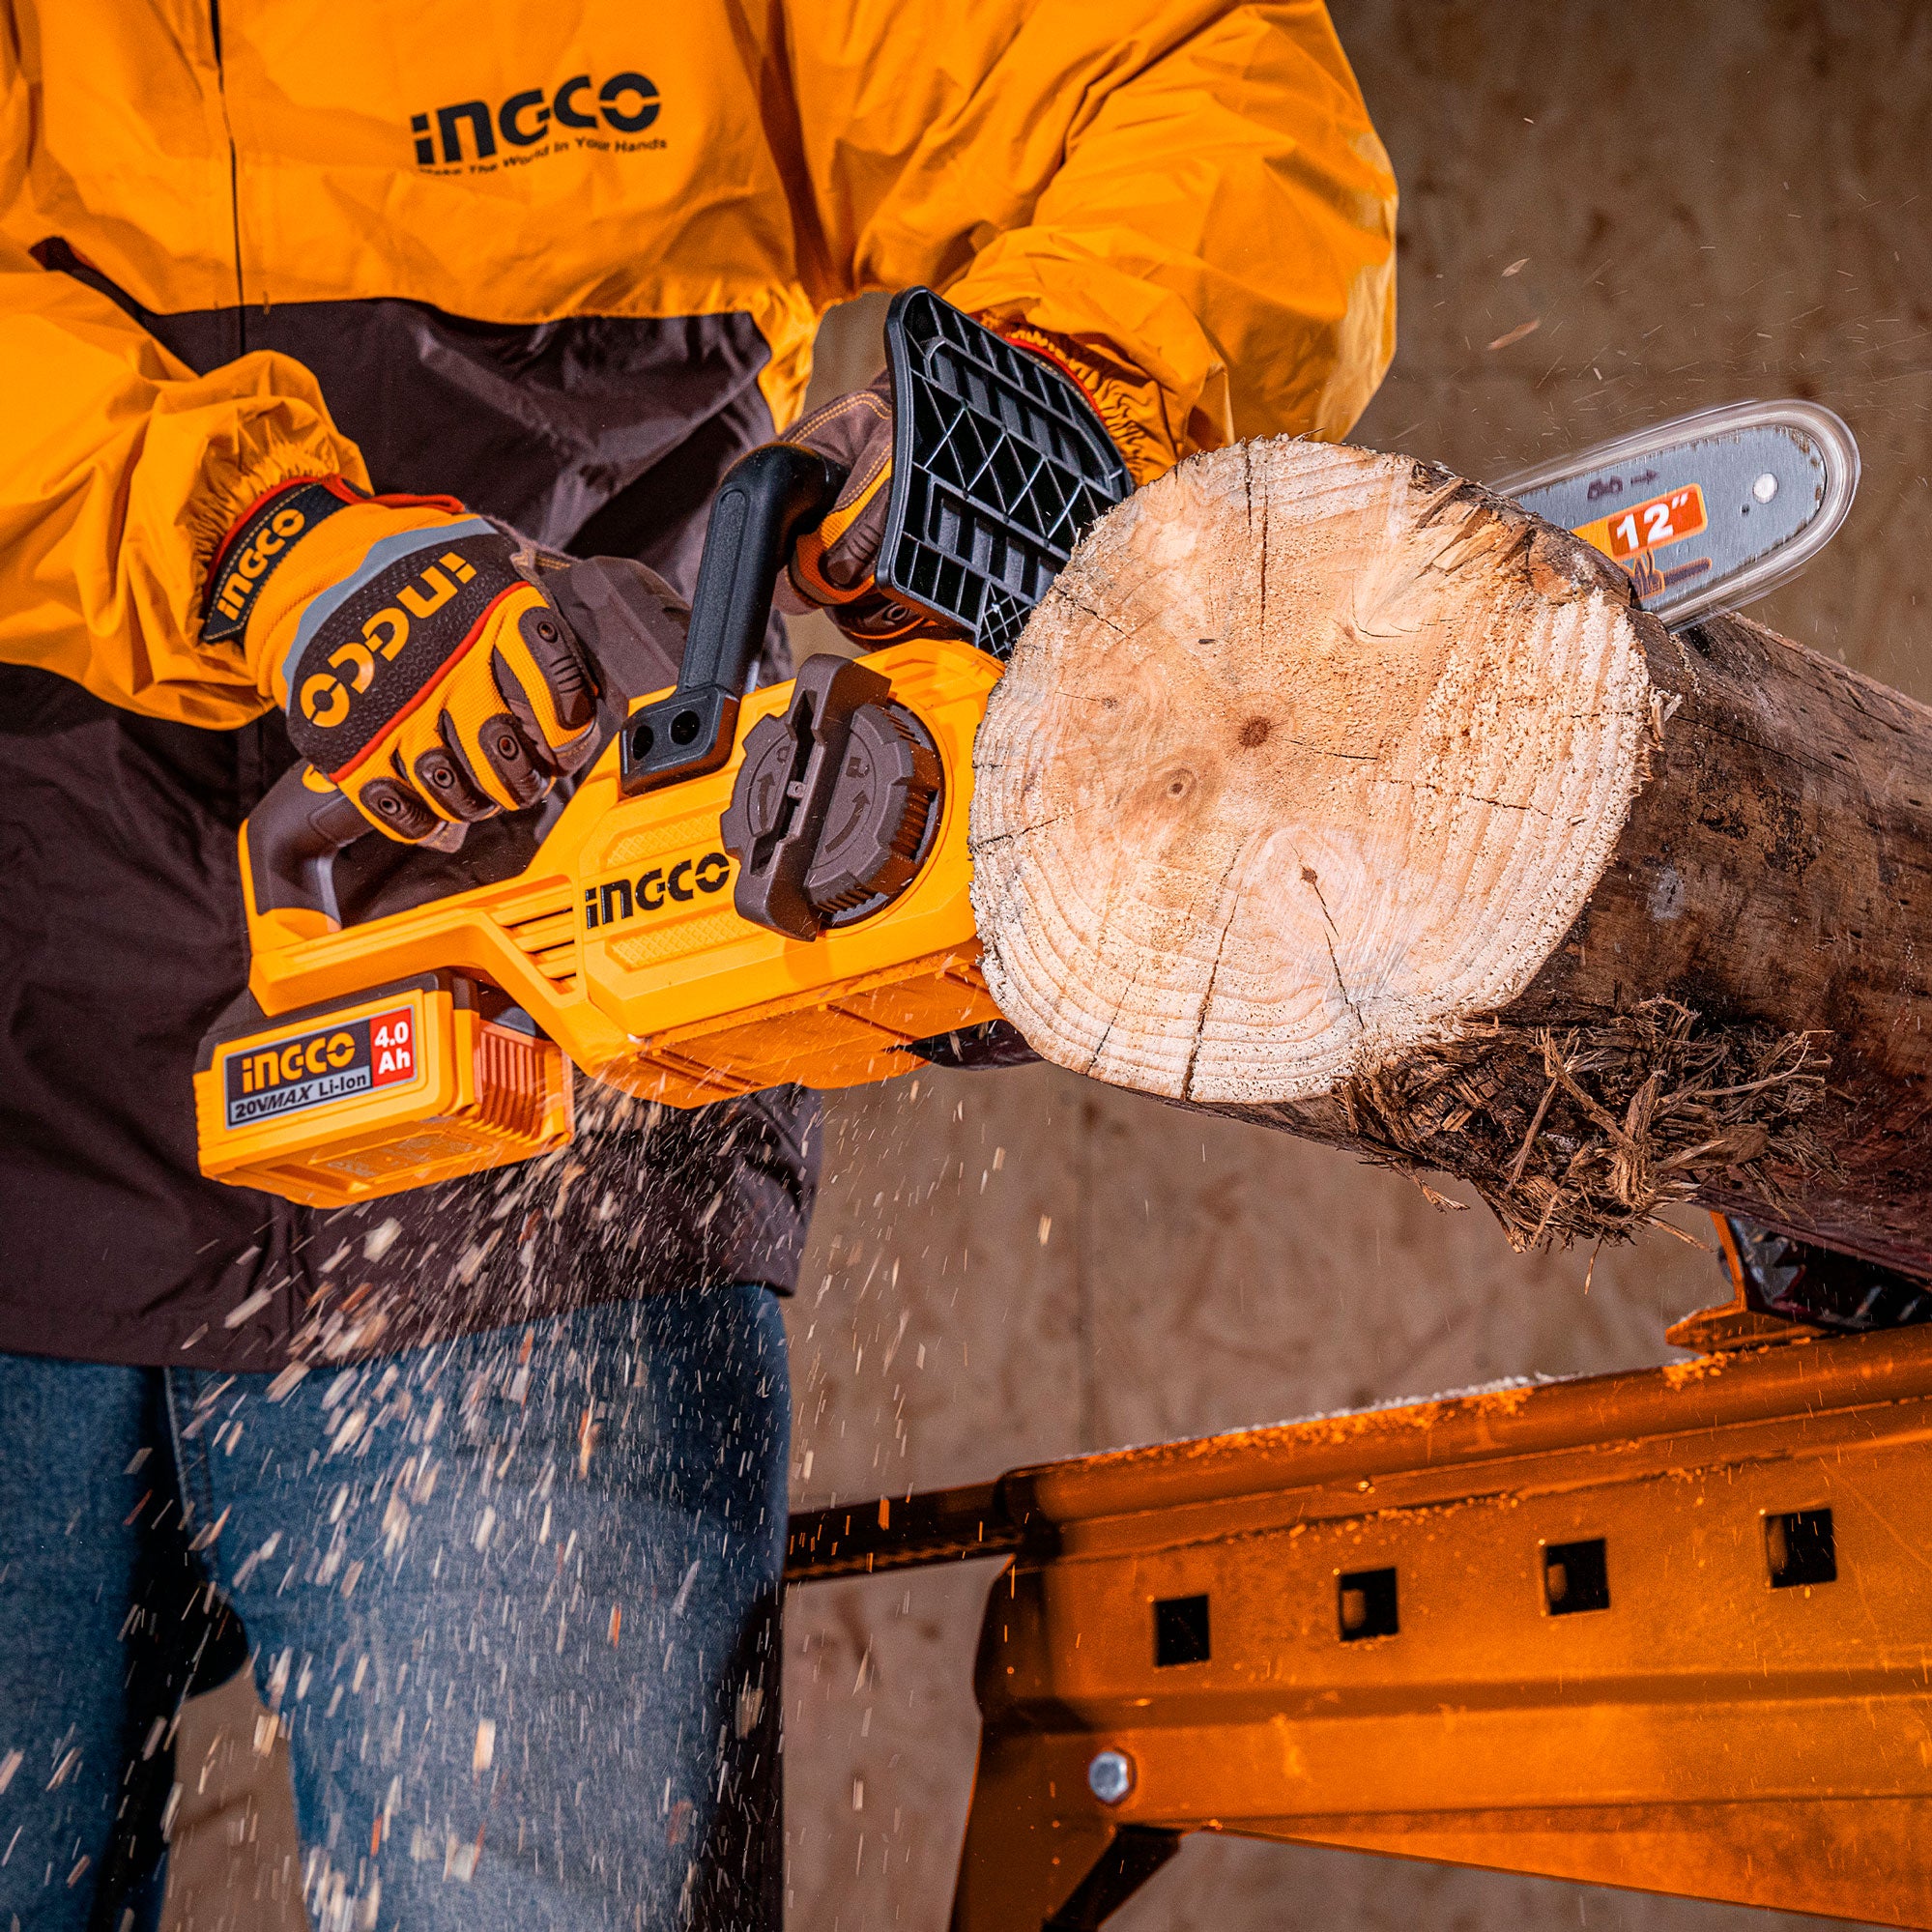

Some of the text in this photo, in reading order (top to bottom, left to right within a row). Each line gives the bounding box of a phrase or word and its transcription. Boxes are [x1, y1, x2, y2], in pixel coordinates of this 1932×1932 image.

[574, 135, 611, 151] Your
[615, 136, 668, 153] Hands
[374, 1021, 409, 1049] 4.0
[378, 1047, 411, 1075] Ah
[318, 1074, 366, 1097] Li-Ion
